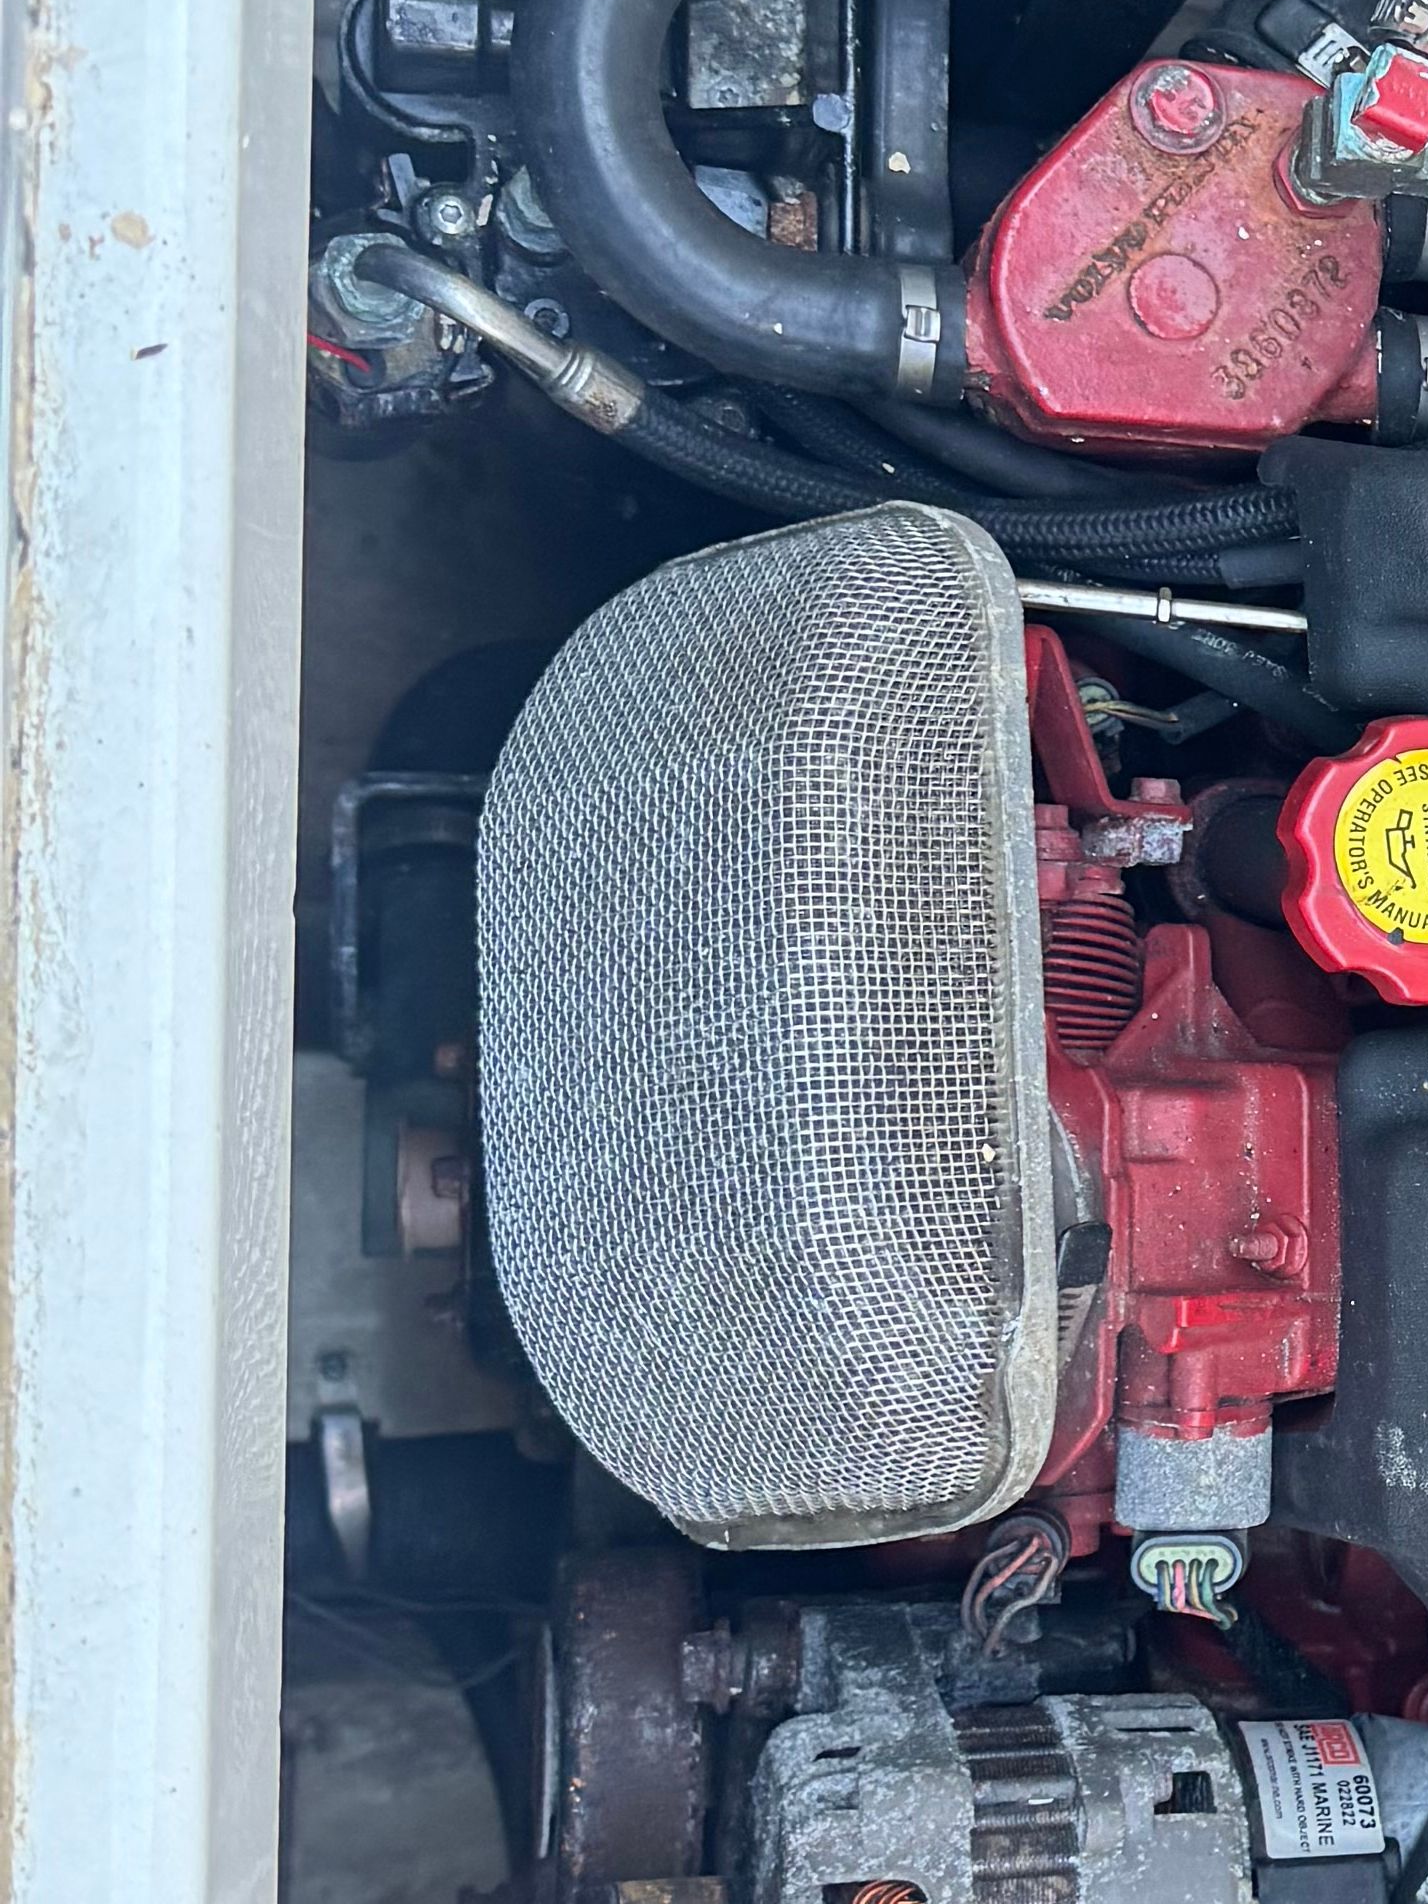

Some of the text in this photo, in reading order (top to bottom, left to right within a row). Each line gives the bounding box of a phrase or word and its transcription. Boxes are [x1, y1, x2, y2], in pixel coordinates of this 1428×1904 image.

[1394, 764, 1428, 787] SEE
[1349, 779, 1394, 889] OPERATOR'S
[1294, 1723, 1335, 1847] SAE J1171 MARINE
[1337, 1780, 1357, 1827] 022822
[1352, 1774, 1377, 1830] 60073
